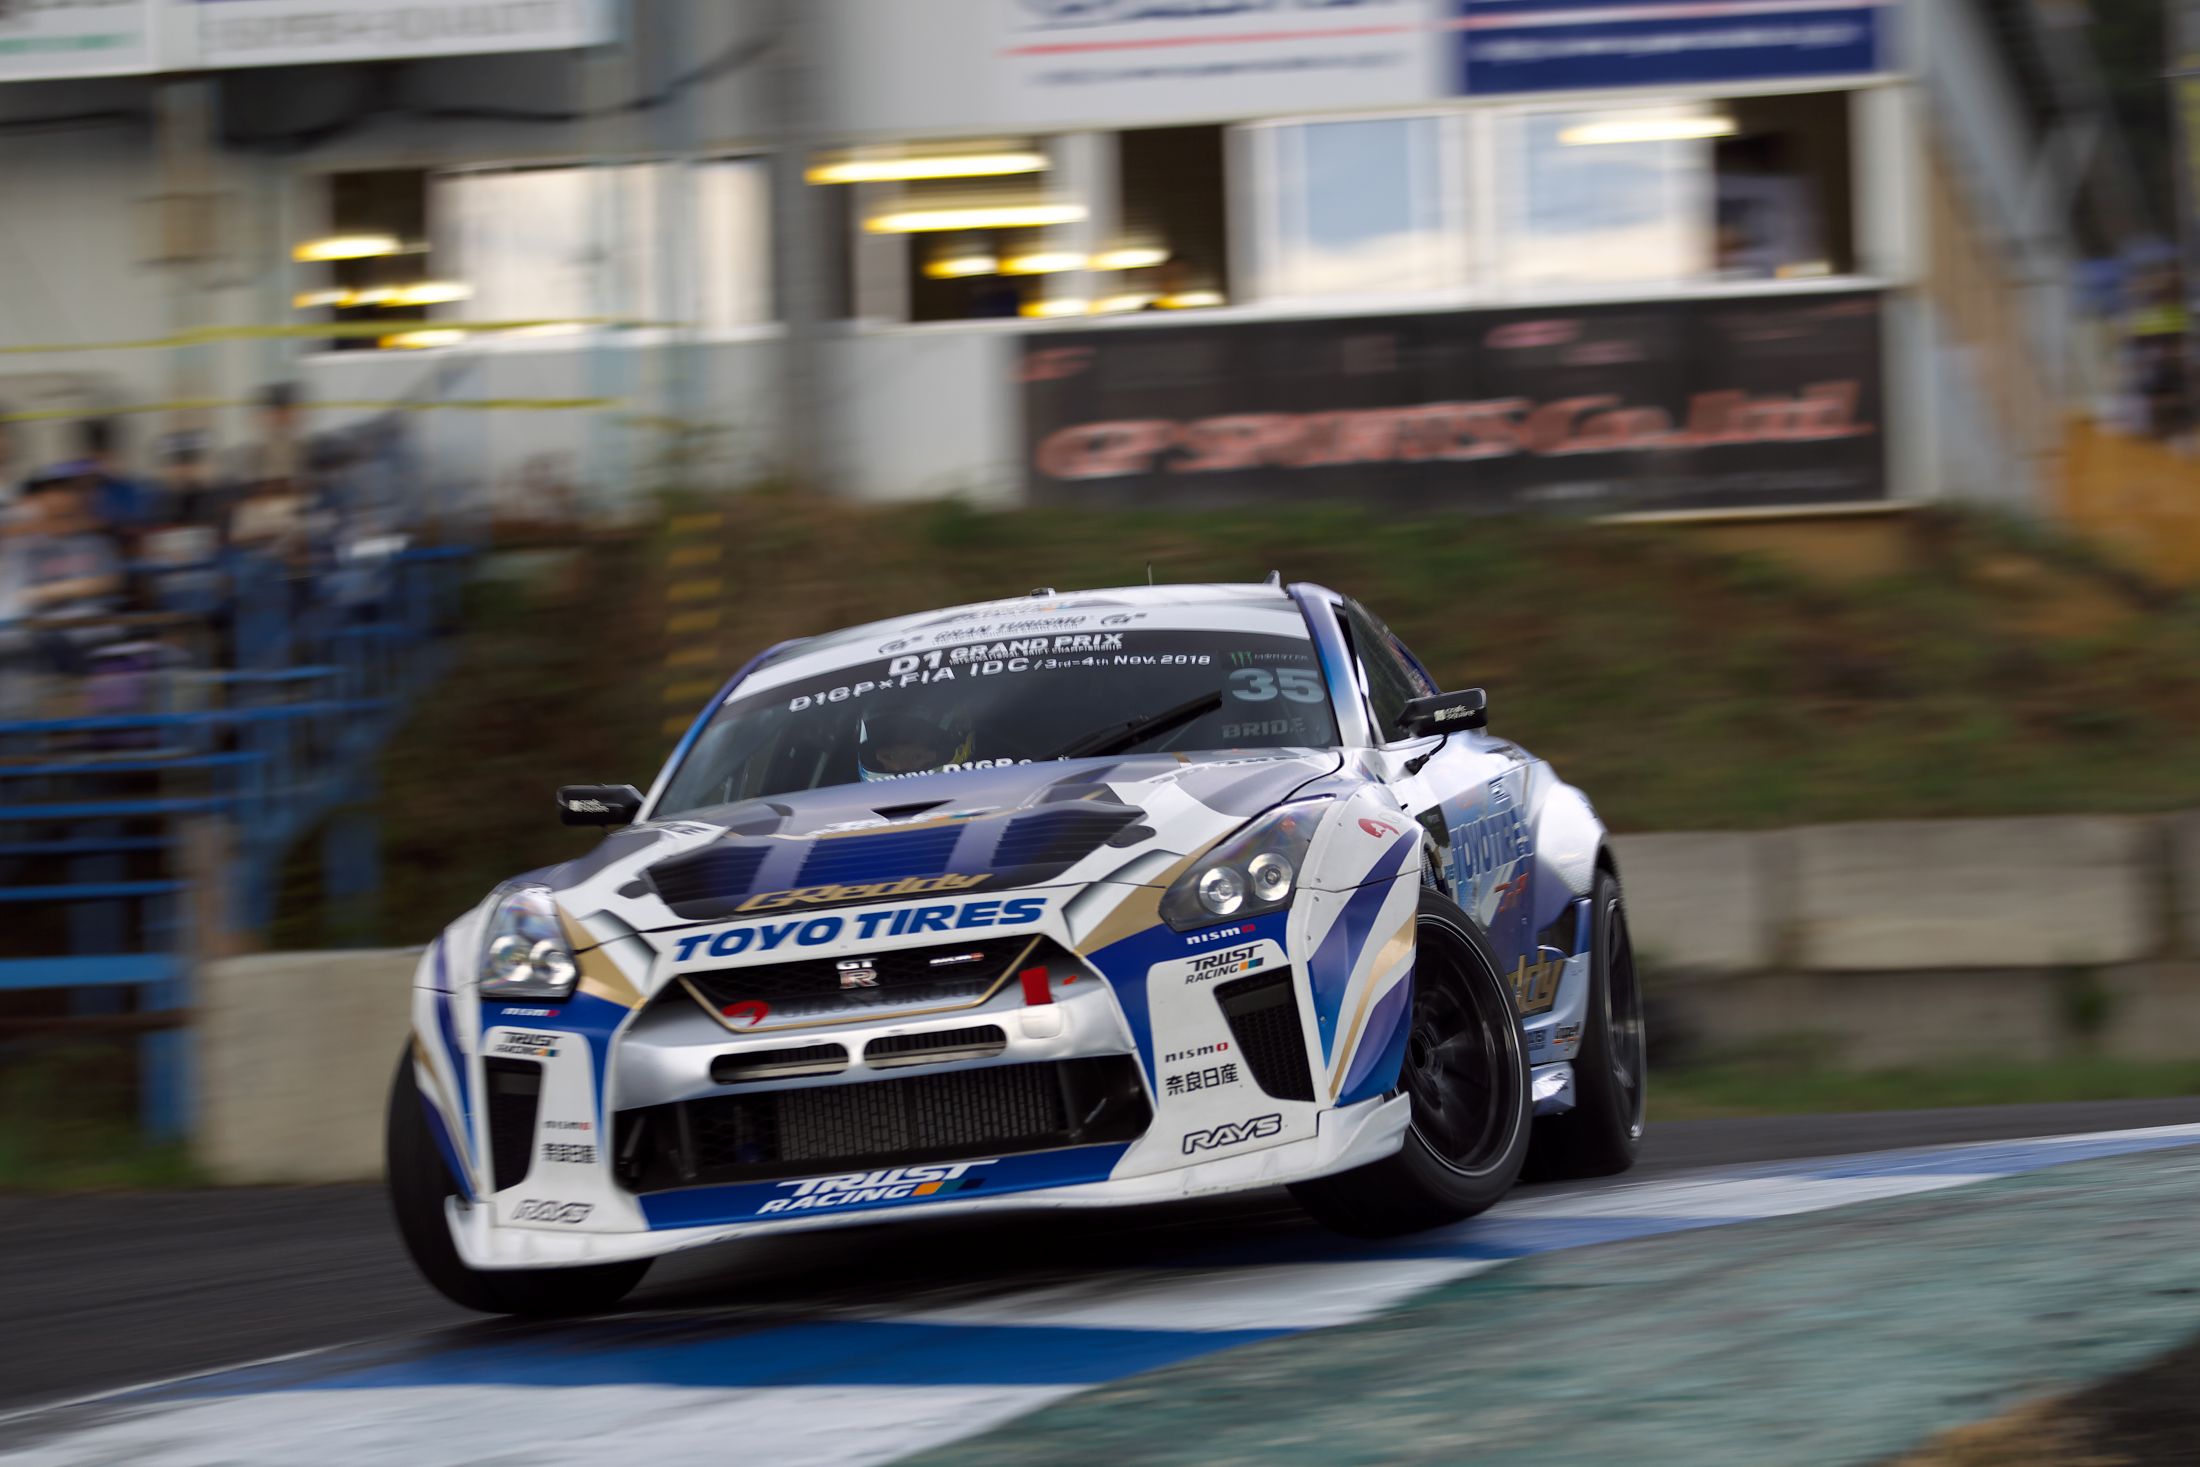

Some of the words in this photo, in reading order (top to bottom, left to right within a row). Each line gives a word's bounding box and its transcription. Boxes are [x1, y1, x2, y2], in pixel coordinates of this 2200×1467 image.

[999, 616, 1087, 632] TURISMO
[949, 638, 1049, 659] GRAND
[1054, 632, 1124, 649] PRIX
[888, 649, 943, 677] D1
[1161, 654, 1211, 666] 2018
[1228, 667, 1326, 704] 35
[735, 873, 994, 912] GReddy
[674, 916, 843, 963] TOYO
[856, 897, 1047, 940] TIRES
[1186, 923, 1256, 945] nismo
[1186, 944, 1264, 972] TRUST
[1185, 962, 1239, 985] RACING
[1164, 1041, 1229, 1063] nismo
[1166, 1063, 1239, 1096] 奈良日産
[1182, 1113, 1281, 1155] RAYS
[776, 1158, 1000, 1197] TRUST
[755, 1183, 914, 1216] RACING
